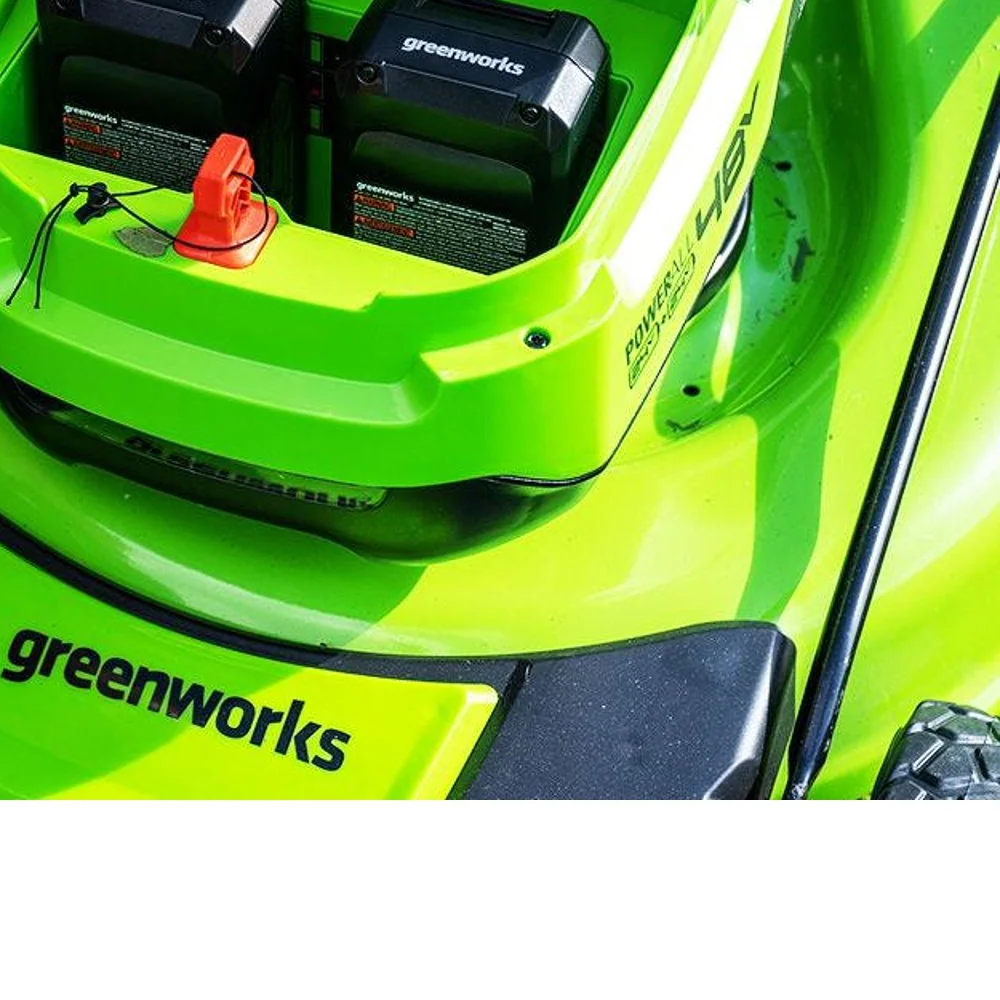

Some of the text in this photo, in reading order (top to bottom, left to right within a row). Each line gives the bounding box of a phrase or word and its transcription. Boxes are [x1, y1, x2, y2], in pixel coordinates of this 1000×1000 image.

[402, 34, 525, 77] greenworks
[63, 104, 118, 125] greenworks
[355, 181, 415, 202] greenworks
[1, 628, 351, 772] greenworks
